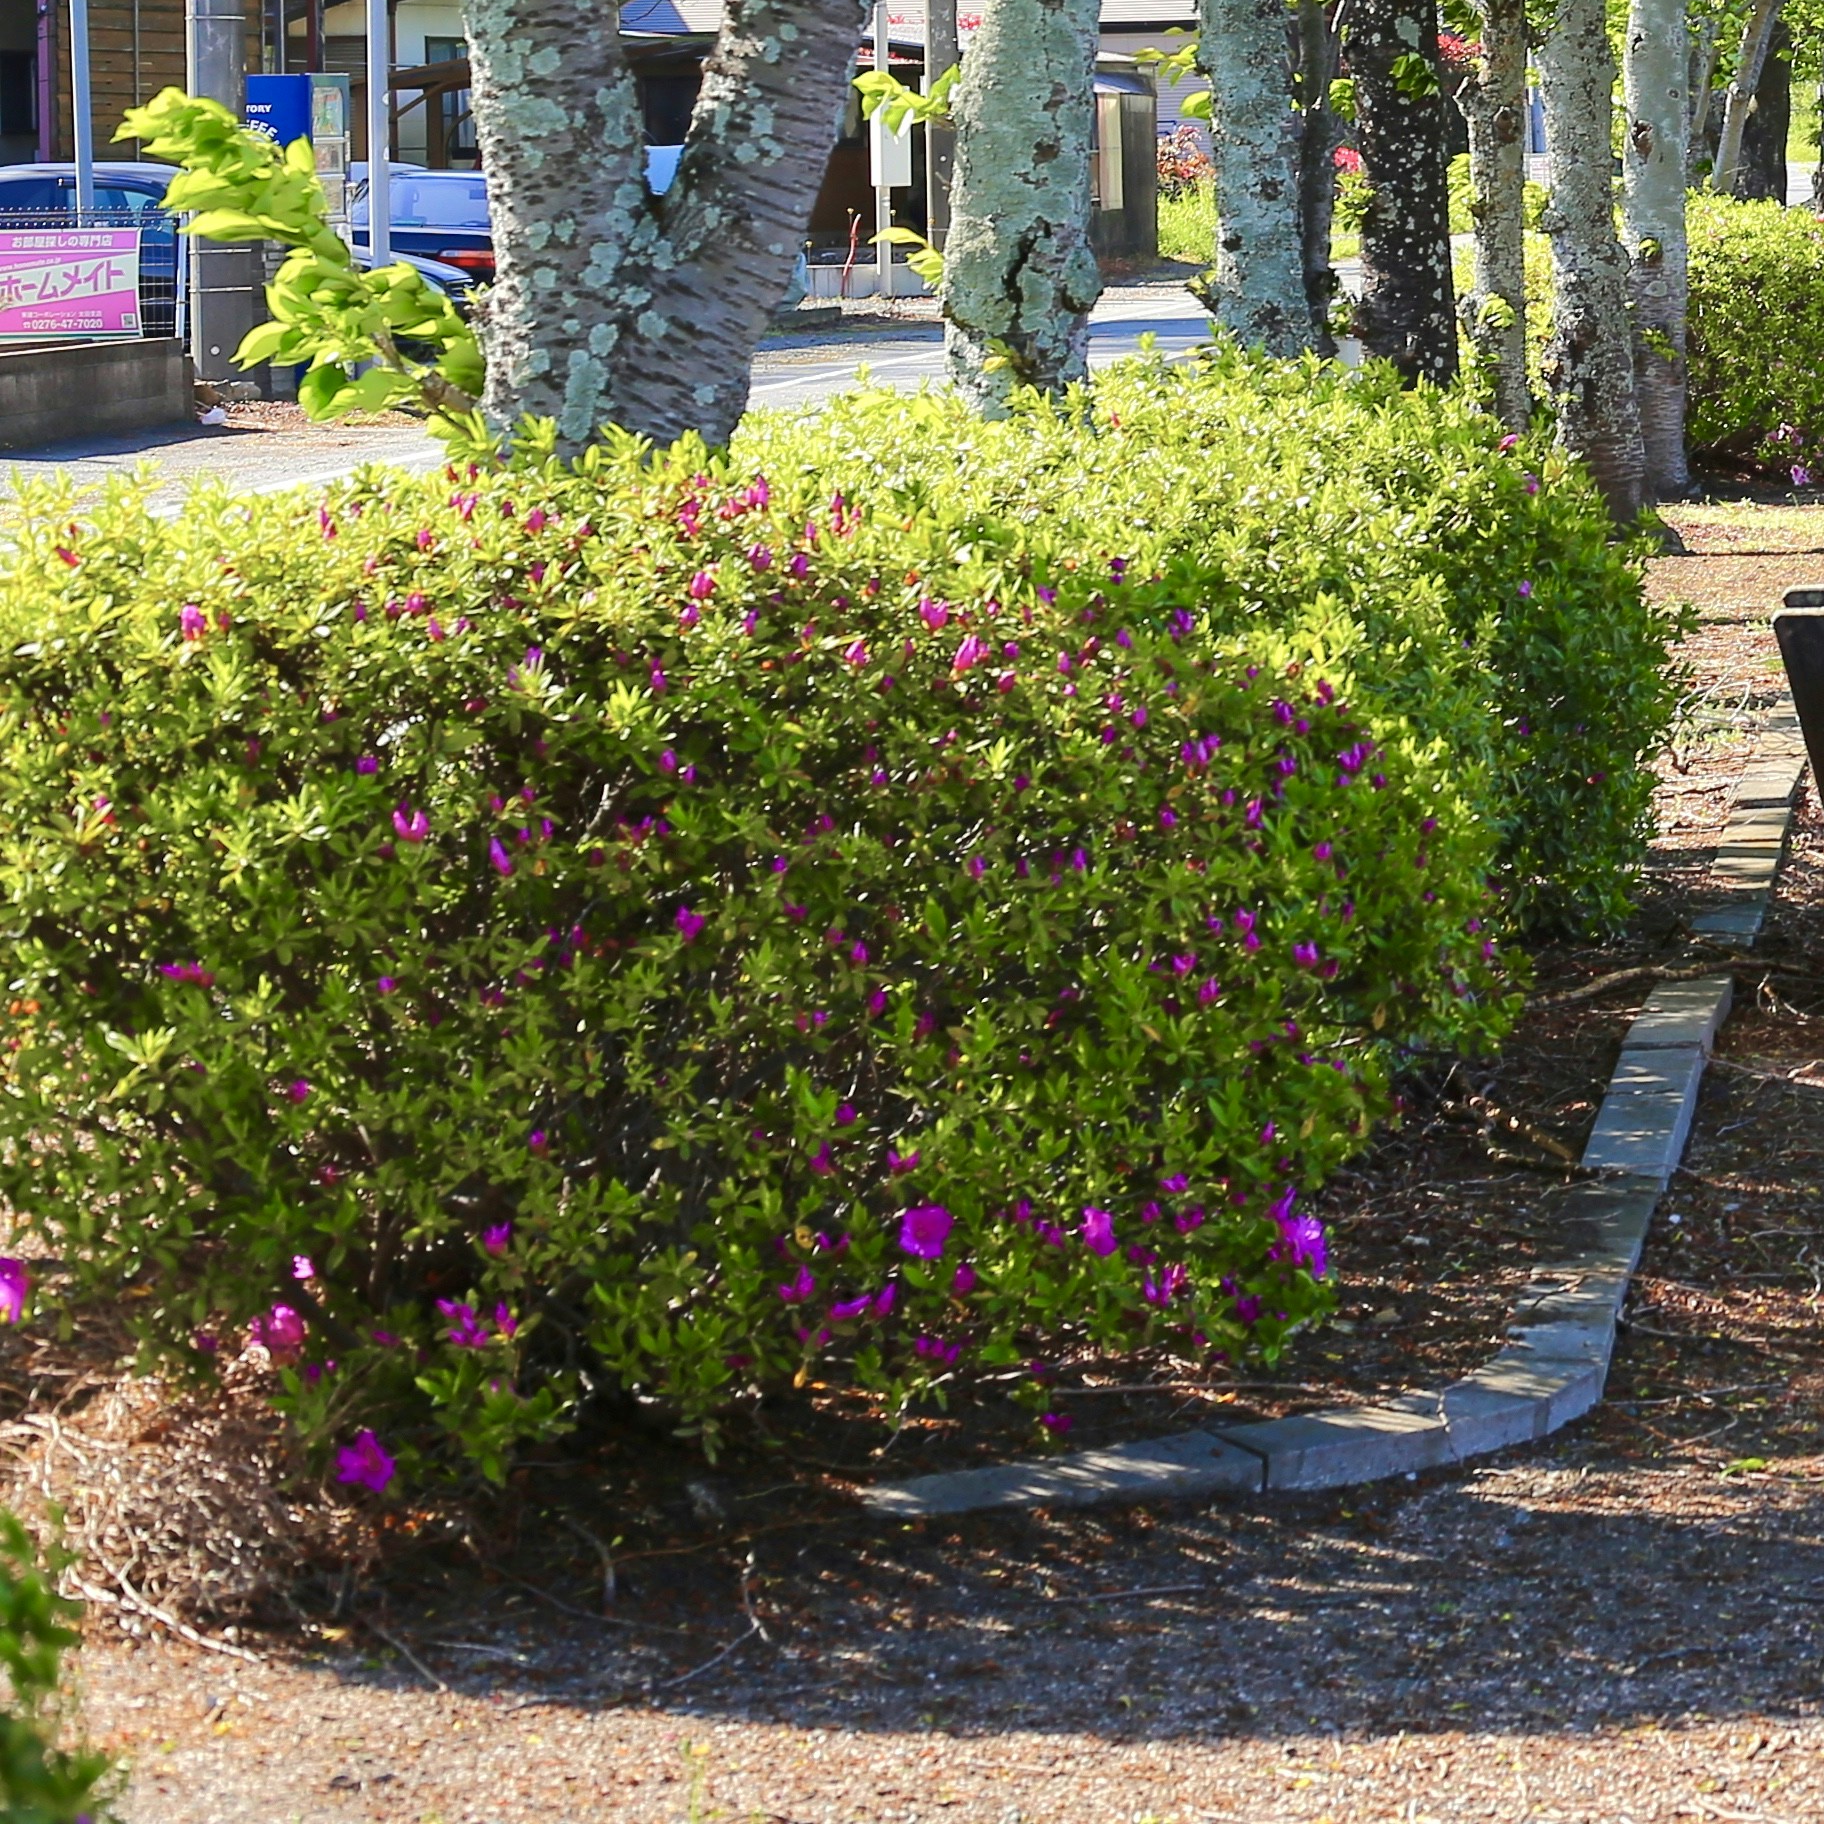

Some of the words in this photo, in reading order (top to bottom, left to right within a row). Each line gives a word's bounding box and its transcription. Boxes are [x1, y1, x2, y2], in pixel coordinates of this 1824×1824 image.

[12, 236, 112, 248] お部屋探しの専門店
[0, 260, 124, 301] ホームメイト
